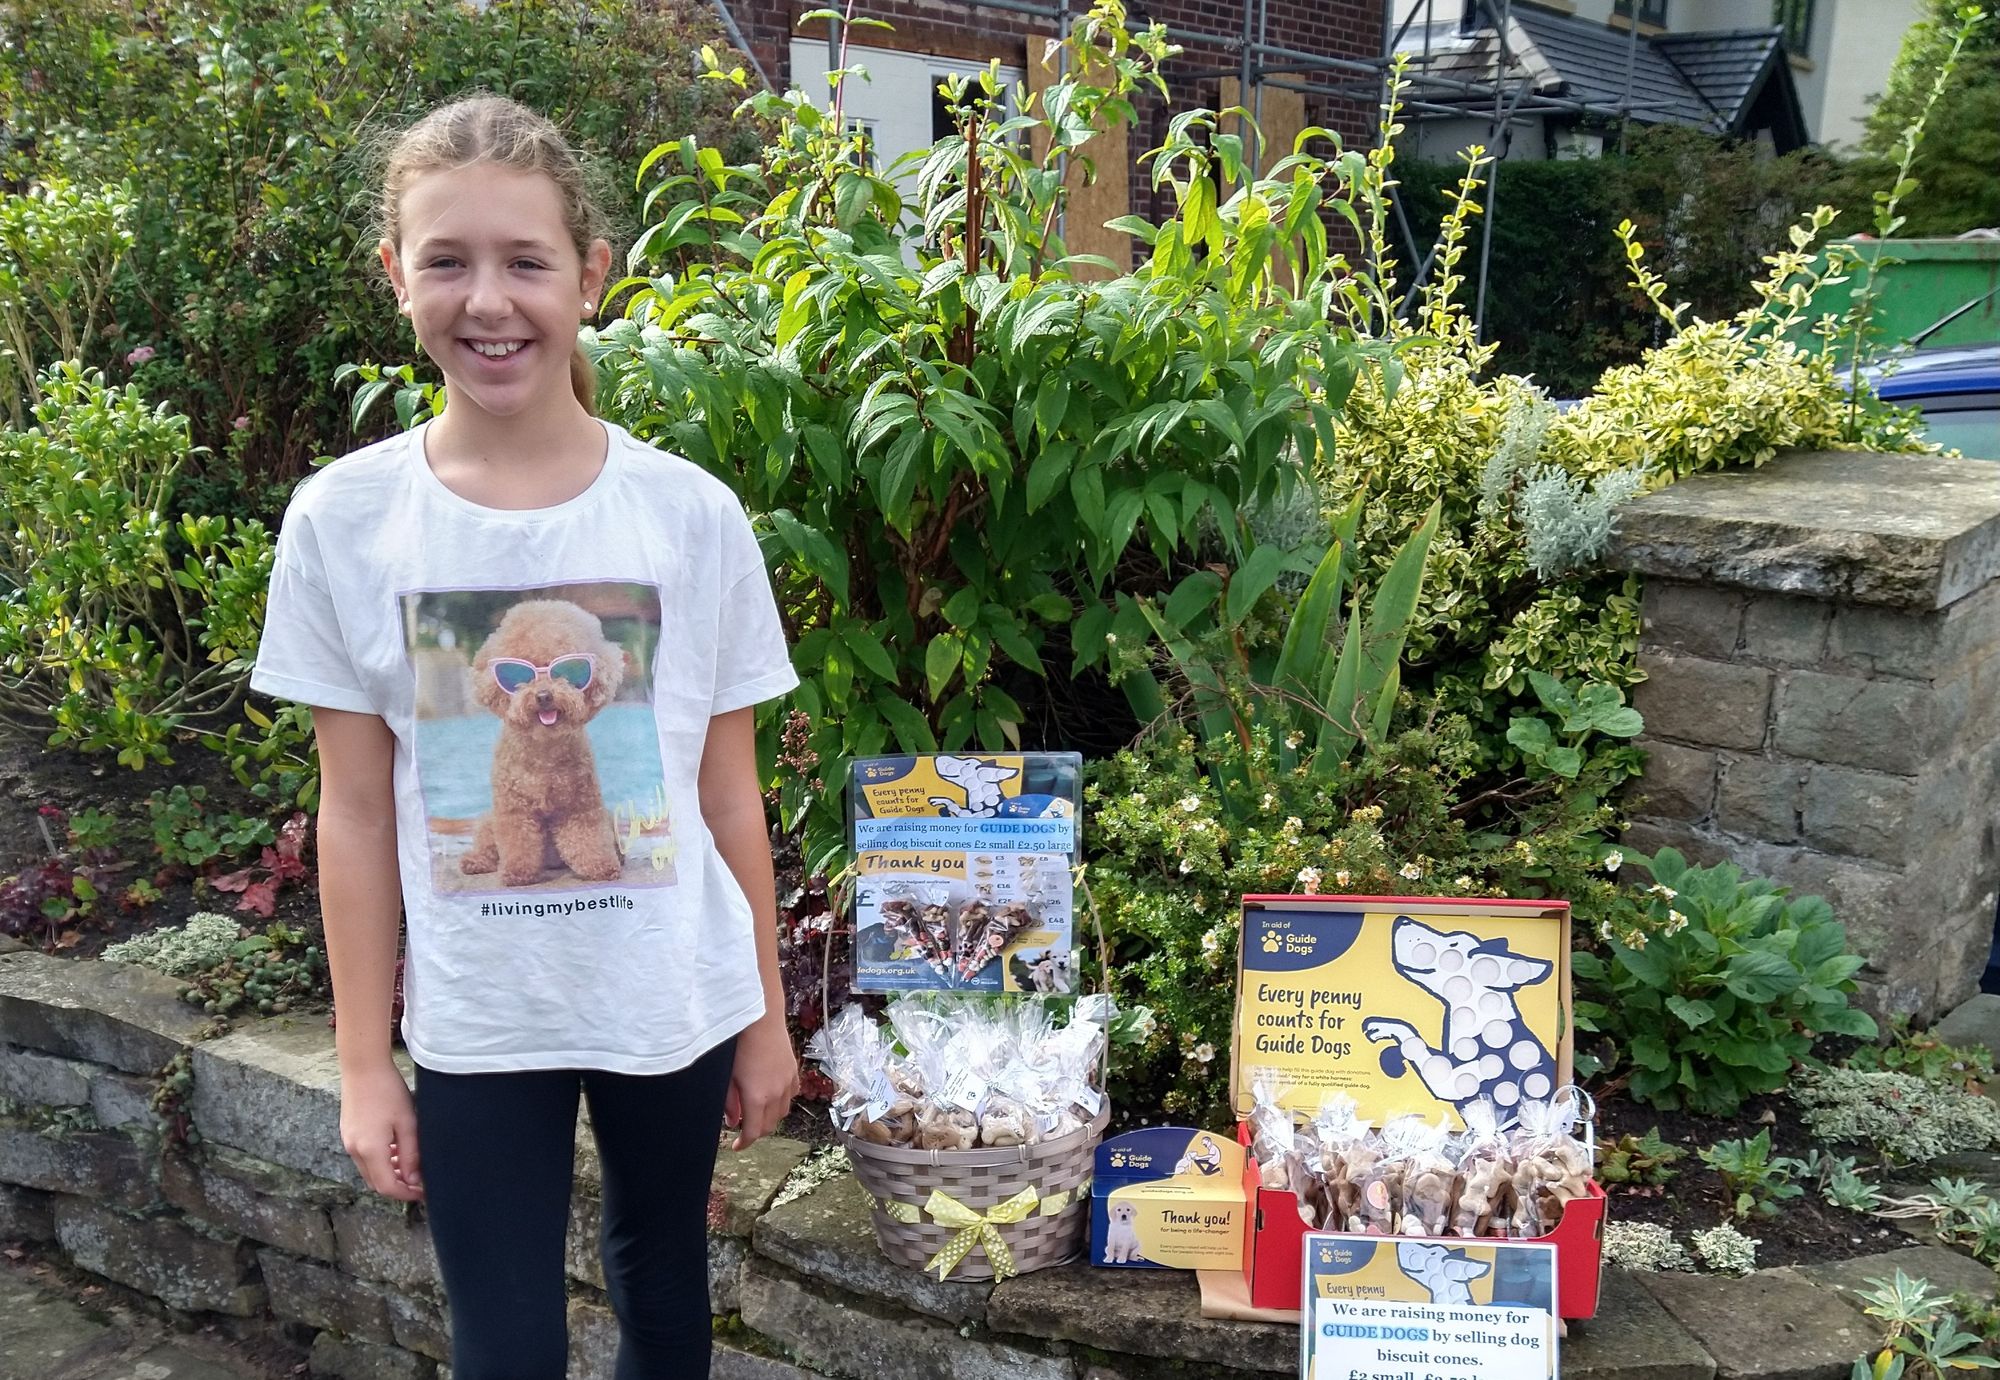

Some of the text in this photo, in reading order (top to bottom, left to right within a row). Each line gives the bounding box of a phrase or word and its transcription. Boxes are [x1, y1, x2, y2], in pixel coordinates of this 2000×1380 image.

[872, 787, 925, 797] Every penny
[876, 796, 919, 806] counts for
[879, 806, 924, 814] Guide Dogs
[858, 825, 874, 833] We
[894, 822, 928, 834] raising
[929, 825, 962, 834] money
[964, 823, 978, 832] for
[980, 824, 1020, 833] GUIDE
[1022, 824, 1056, 834] DOGS
[1058, 824, 1070, 834] by
[857, 839, 888, 850] selling
[890, 838, 908, 848] dog
[910, 838, 942, 848] biscuit
[974, 840, 986, 849] £2
[989, 840, 1014, 849] small
[1018, 840, 1046, 851] £2.50
[1048, 840, 1072, 850] large
[865, 855, 964, 872] Thank you
[480, 895, 634, 917] #livingmybestlife
[1286, 934, 1317, 944] Guide
[1286, 944, 1313, 956] Dogs
[1258, 984, 1362, 1010] Every penny
[1257, 1010, 1346, 1030] counts for
[1256, 1034, 1352, 1060] Guide Dogs
[1129, 1154, 1152, 1162] Guide
[1161, 1210, 1231, 1228] Thank you!
[1193, 1228, 1230, 1236] life-changer
[1335, 1256, 1352, 1264] Dogs
[1327, 1282, 1385, 1297] Every penny
[1332, 1304, 1530, 1325] We are raising money for
[1322, 1324, 1540, 1349] GUIDE DOGS by selling dog
[1377, 1348, 1484, 1366] biscuit cones.
[1348, 1370, 1368, 1380] £2
